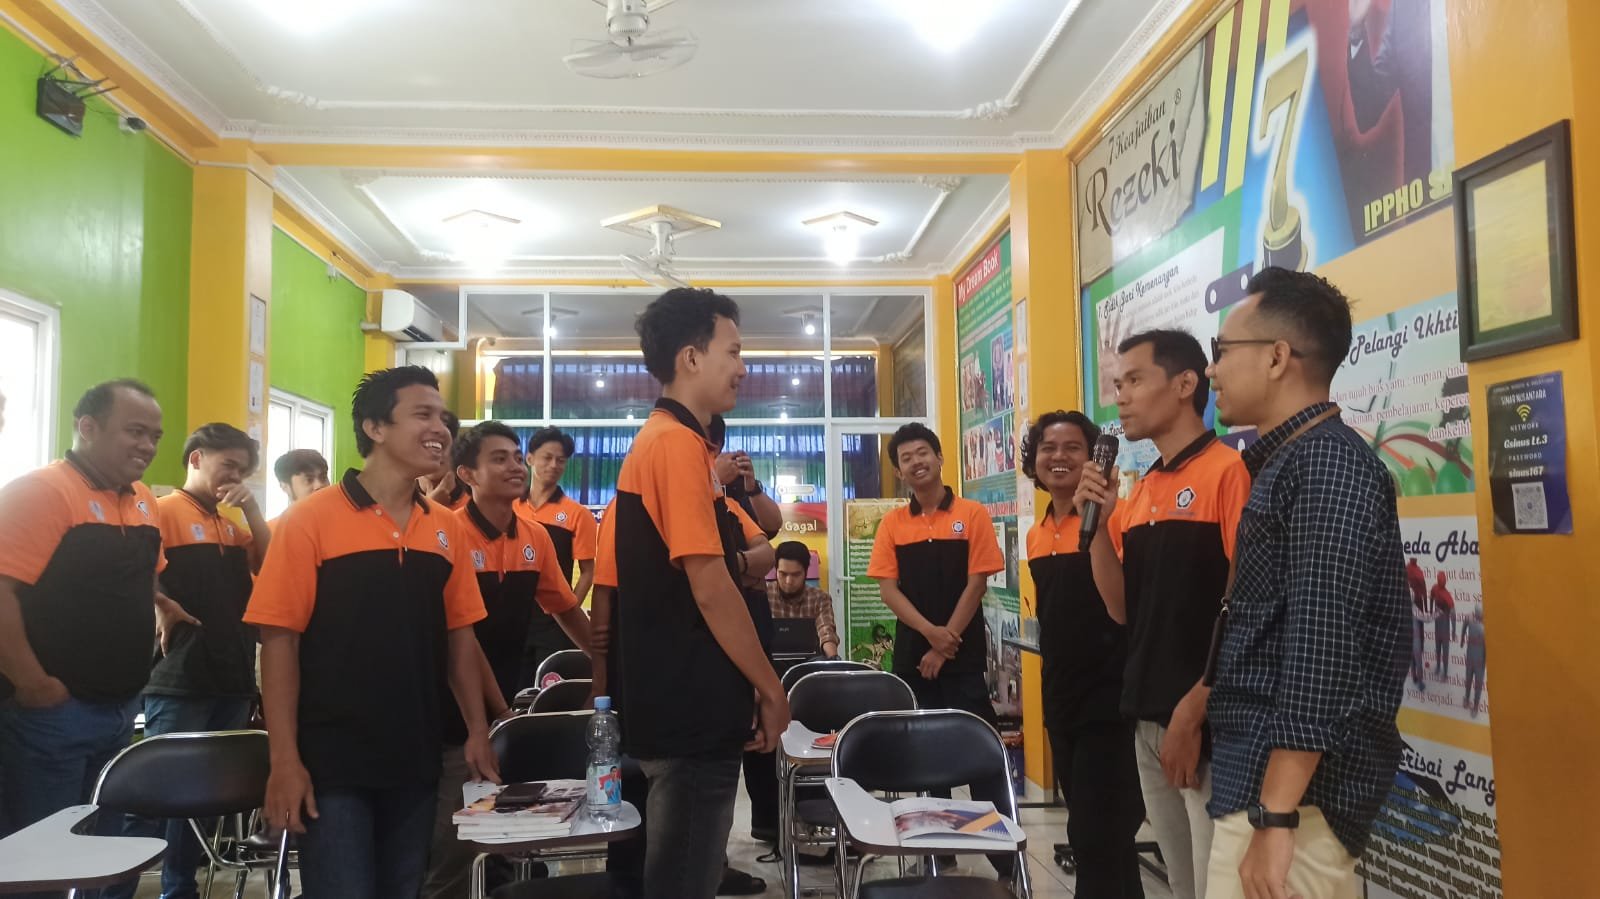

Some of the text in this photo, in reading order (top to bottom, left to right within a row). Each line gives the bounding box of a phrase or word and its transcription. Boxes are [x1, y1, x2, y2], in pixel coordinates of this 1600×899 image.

[1108, 136, 1115, 166] 7
[1115, 100, 1167, 160] Keajaiban
[1085, 118, 1180, 237] Rezeki
[1364, 178, 1424, 233] IPPHO
[958, 250, 999, 302] My Dream Book
[1135, 264, 1179, 297] Kemenangan
[1349, 309, 1458, 366] Pelangi Ikhti
[1504, 438, 1531, 449] Gsinus
[1510, 421, 1539, 433] NETWORK
[1508, 452, 1542, 462] PASSWORD
[785, 519, 817, 534] Gagal
[1403, 530, 1480, 563] eda Aba
[1445, 759, 1496, 807] Lang
